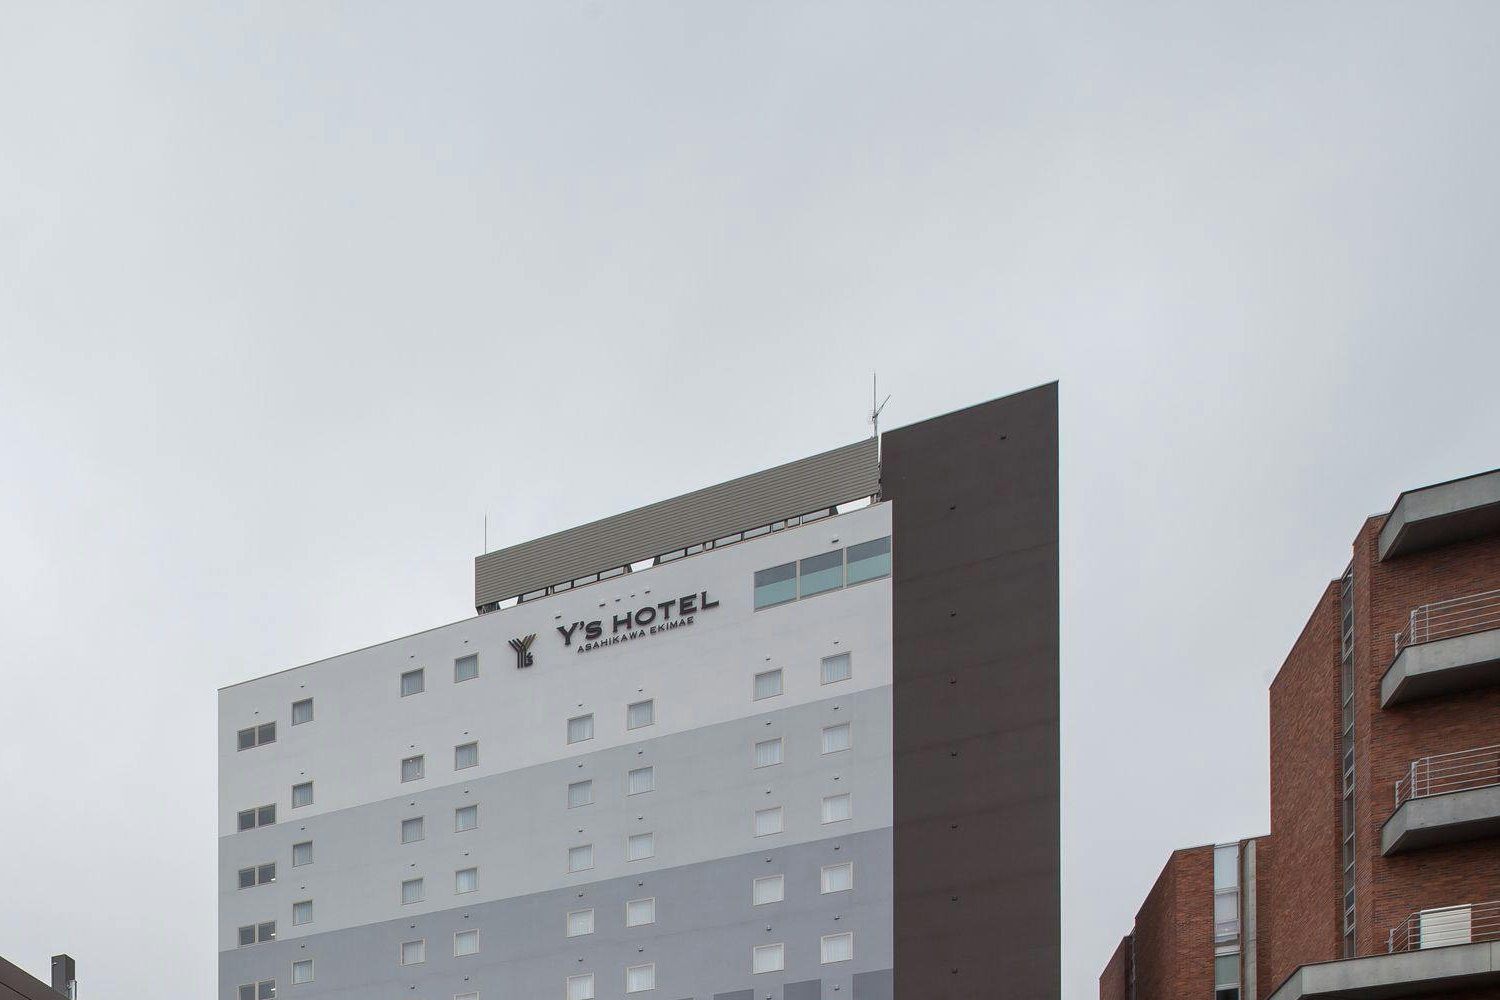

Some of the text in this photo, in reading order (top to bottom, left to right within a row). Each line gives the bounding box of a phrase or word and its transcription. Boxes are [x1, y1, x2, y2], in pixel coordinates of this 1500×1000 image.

[612, 590, 720, 634] HOTEL
[577, 616, 694, 654] ASAHIKAWA EKIMAE
